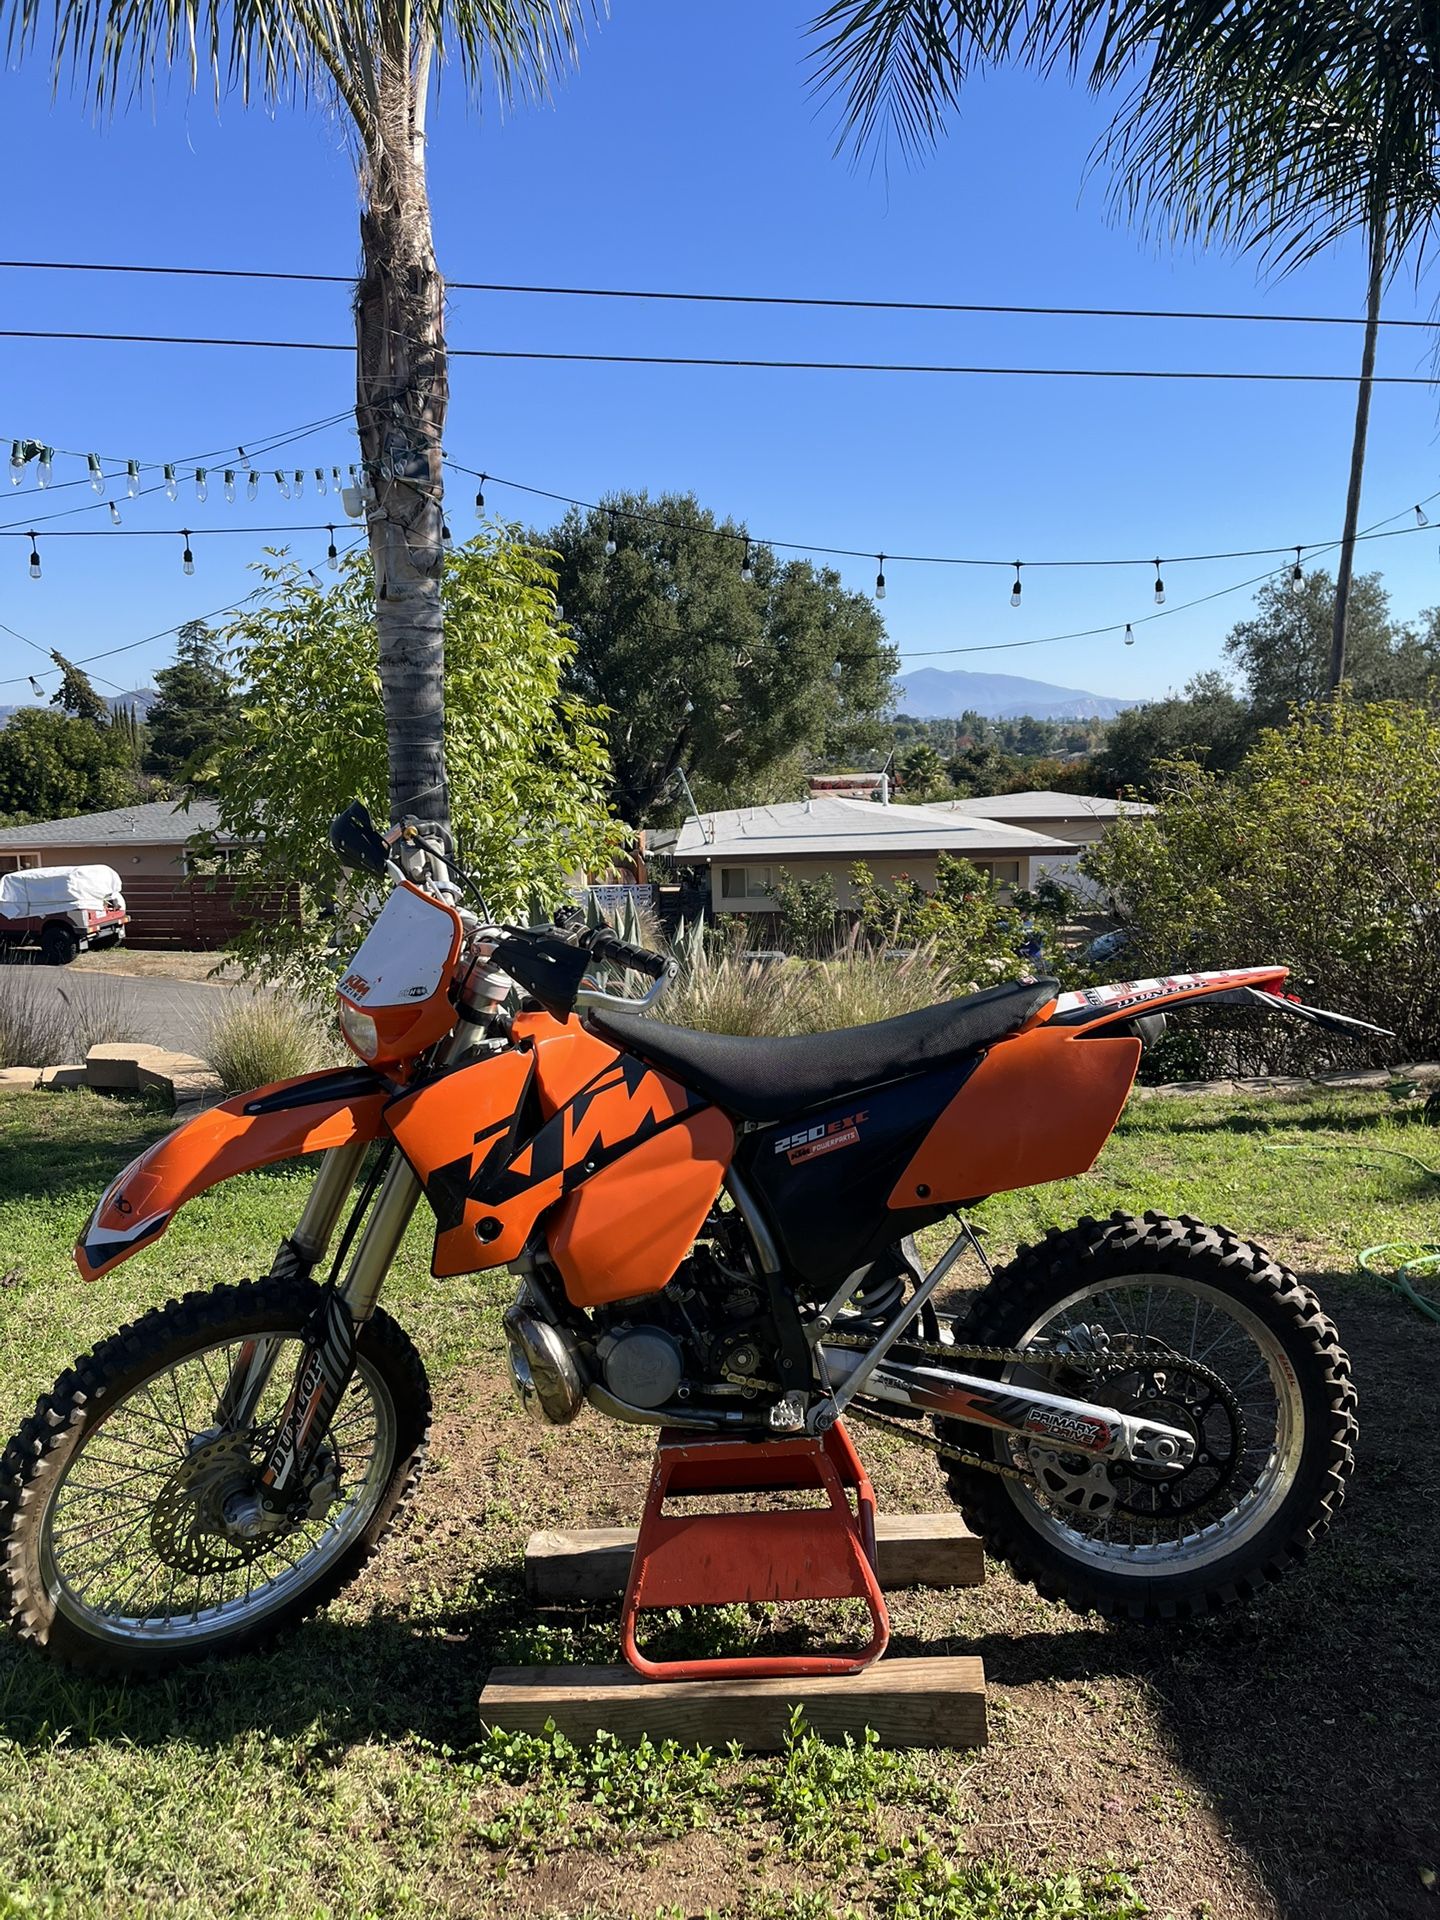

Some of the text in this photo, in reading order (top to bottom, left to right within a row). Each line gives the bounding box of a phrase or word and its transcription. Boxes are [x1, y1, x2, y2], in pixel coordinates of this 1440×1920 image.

[340, 982, 362, 1001] RACING
[345, 974, 371, 996] KTM
[1118, 981, 1211, 1008] DUNLOP
[774, 1109, 870, 1154] 250 EXC
[811, 1131, 856, 1153] POWERPARTS
[1029, 1408, 1100, 1436] PRIMARY
[1048, 1424, 1096, 1445] DRIVE
